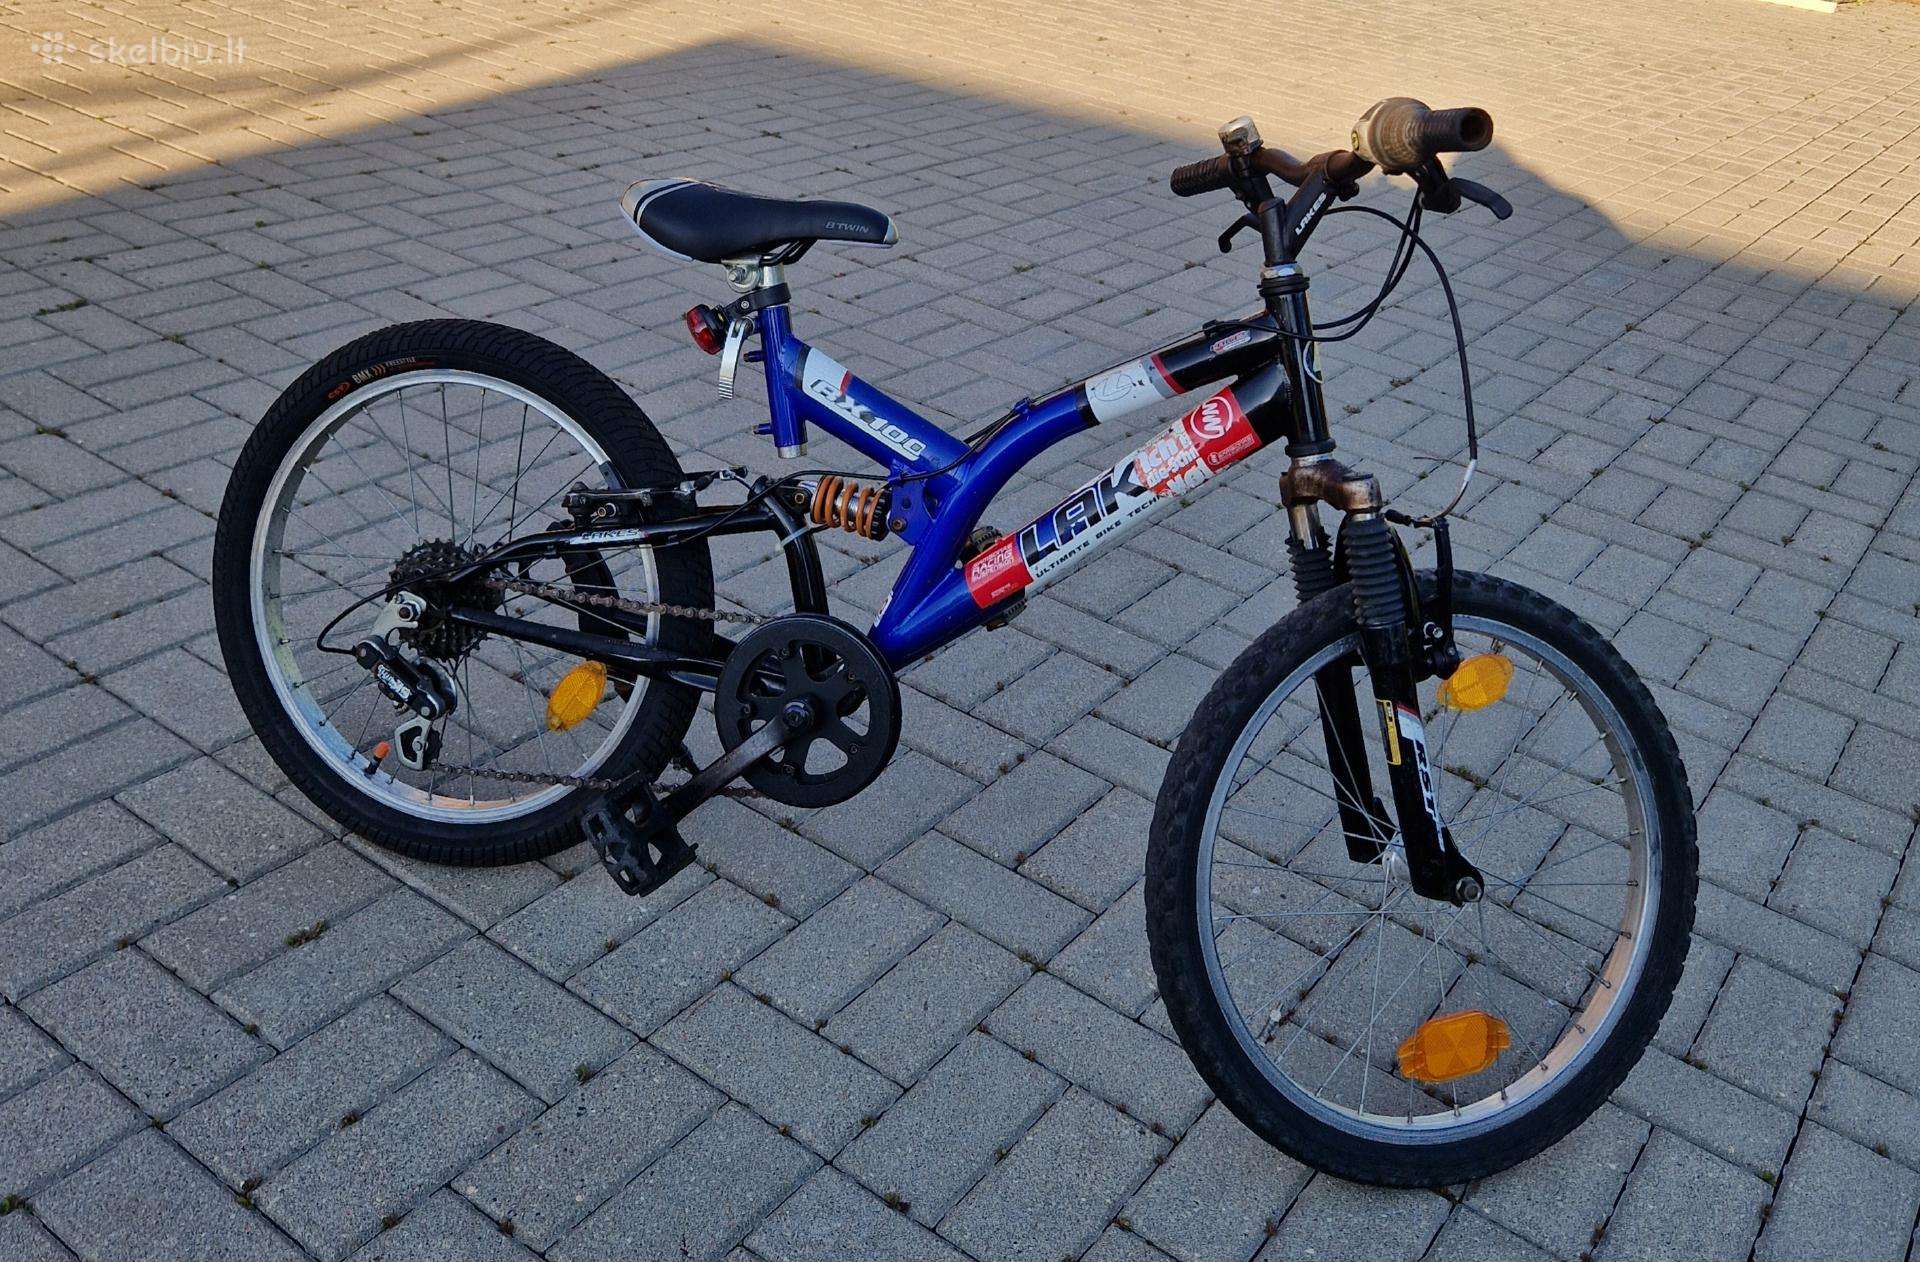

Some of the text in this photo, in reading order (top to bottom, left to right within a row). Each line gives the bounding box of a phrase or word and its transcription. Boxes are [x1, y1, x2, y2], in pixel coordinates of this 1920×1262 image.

[1294, 192, 1327, 236] LAKES
[351, 369, 373, 384] BMX
[868, 416, 927, 458] 100
[1019, 458, 1150, 569] LAK
[1035, 538, 1091, 579] ULTIMATE
[1095, 519, 1122, 541] BIKE
[1126, 493, 1169, 519] TECHN
[972, 548, 1014, 577] RACING
[1415, 741, 1436, 818] RST
